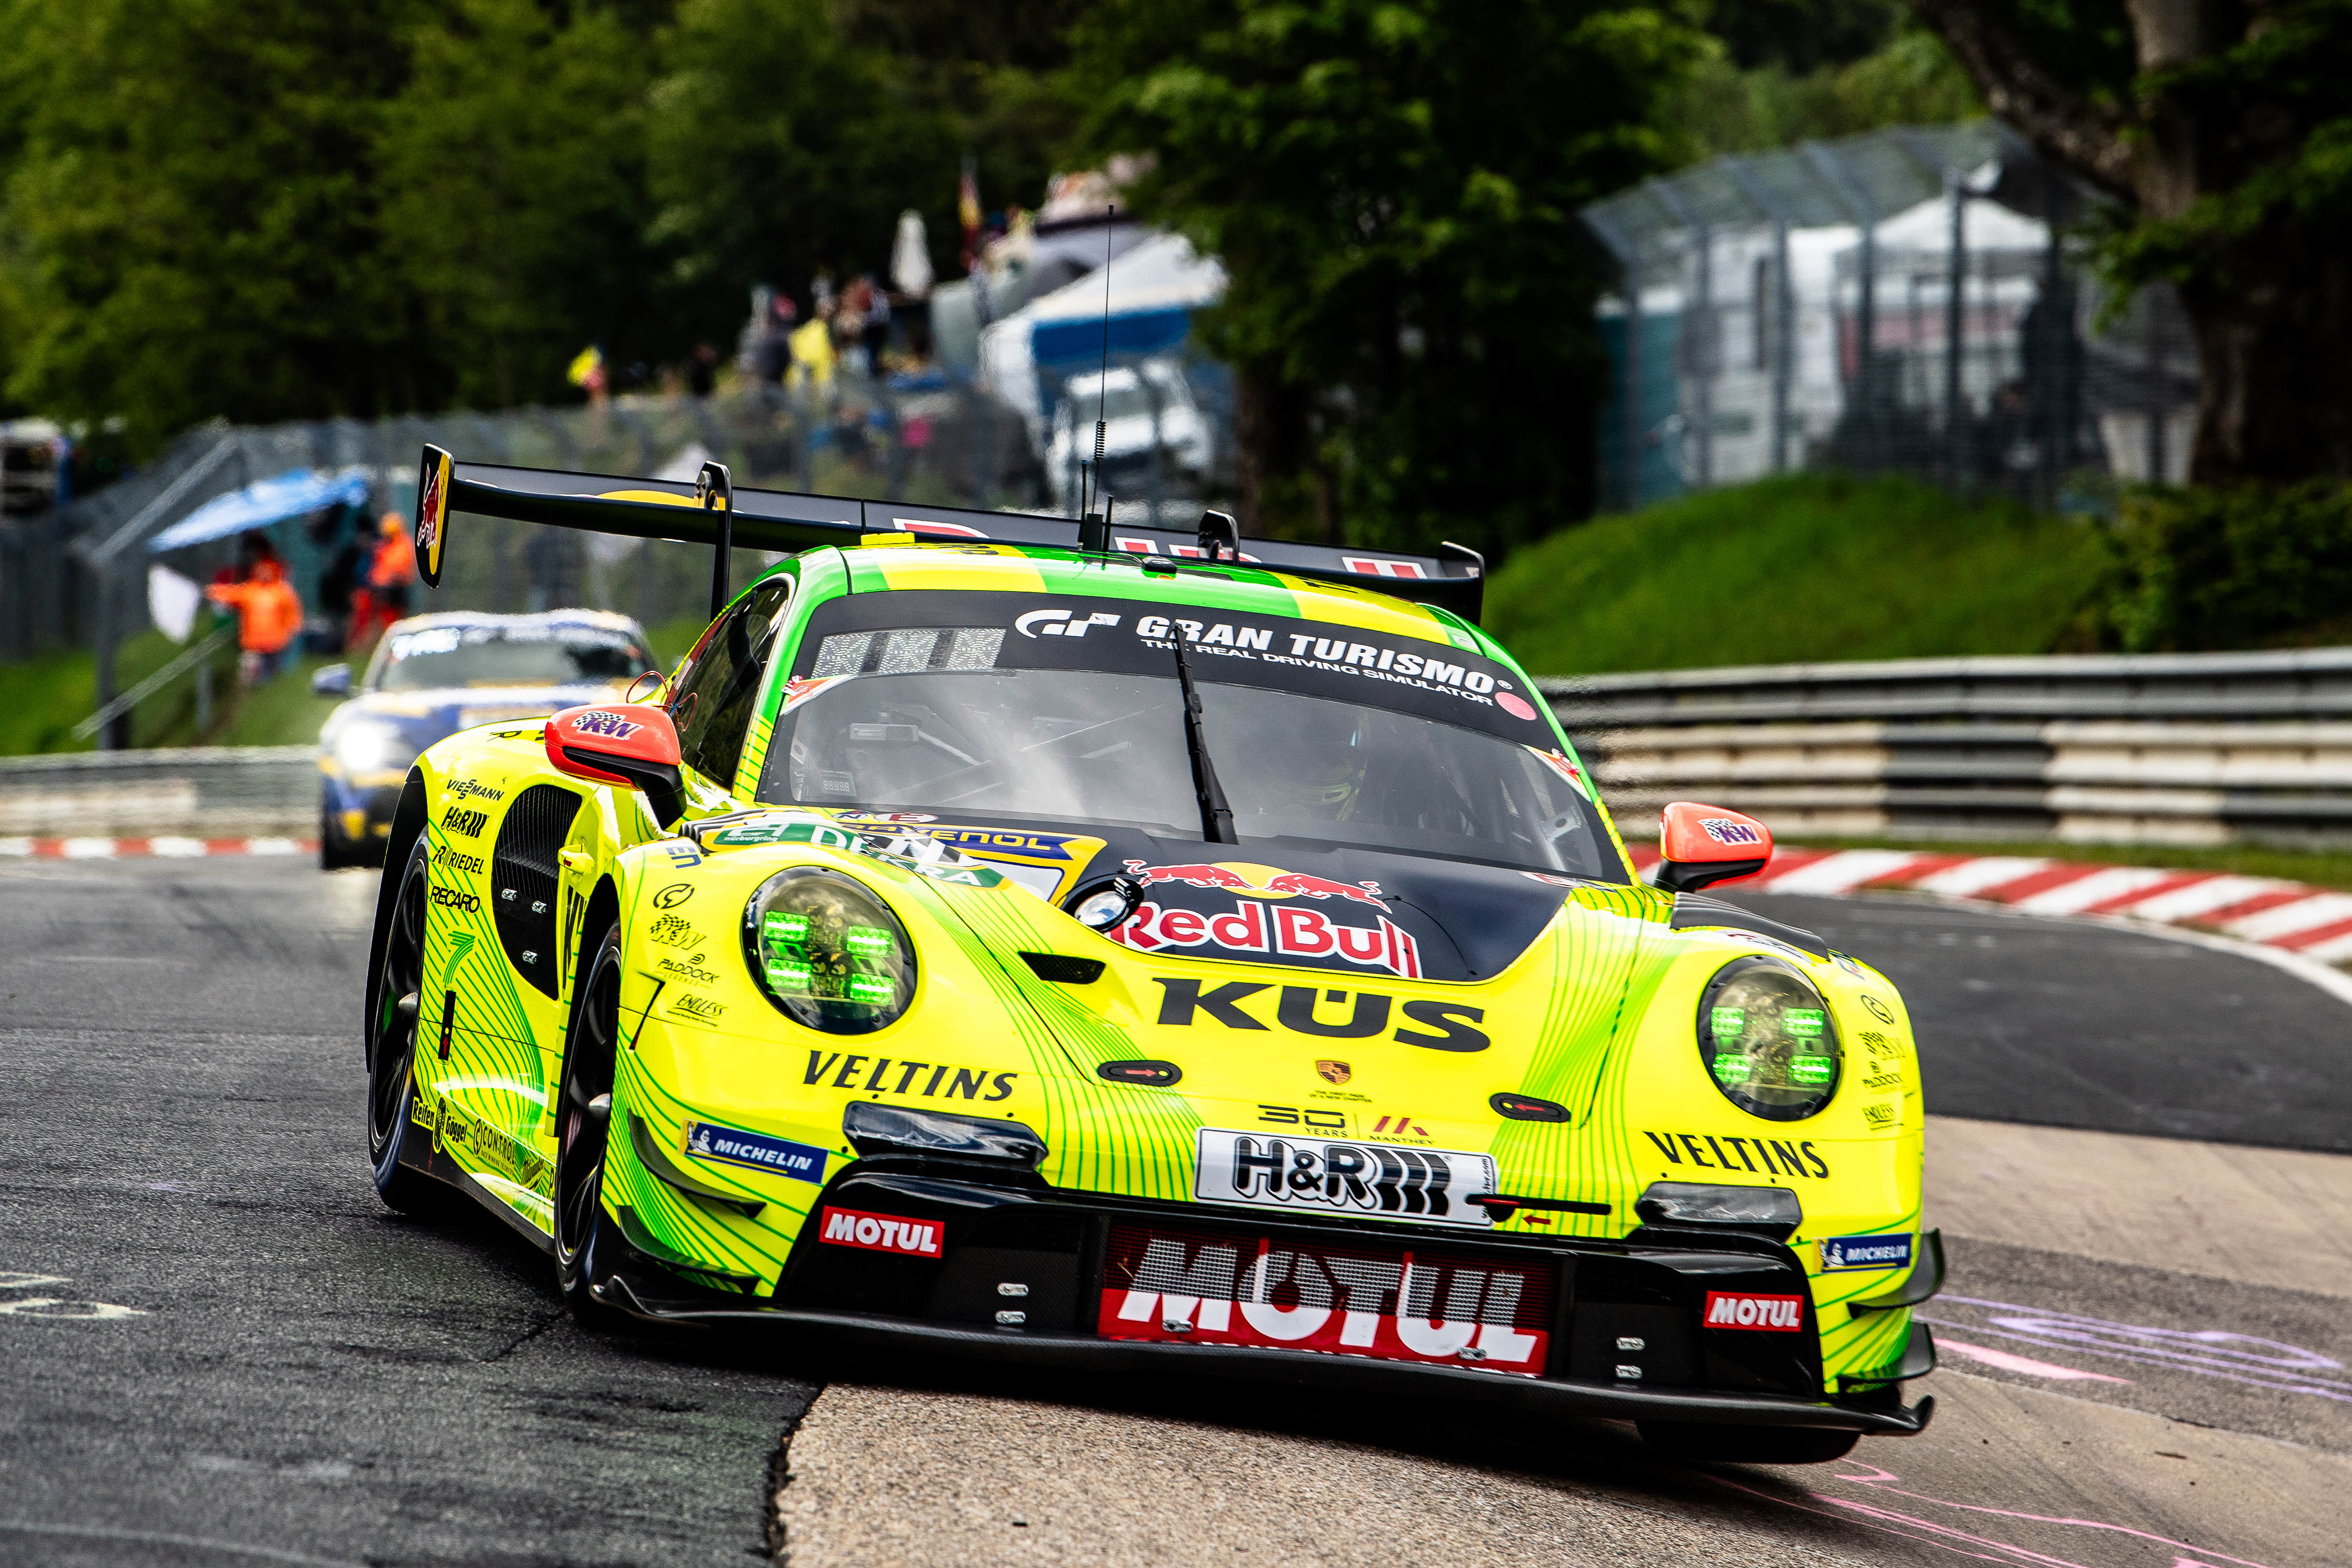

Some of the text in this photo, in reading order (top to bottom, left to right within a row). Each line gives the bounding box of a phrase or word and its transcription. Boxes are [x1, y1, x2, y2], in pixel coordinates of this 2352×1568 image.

[1136, 616, 1273, 650] GRAN
[1195, 644, 1257, 660] REAL
[1263, 654, 1359, 675] DRIVING
[1362, 668, 1494, 706] SIMULATOR
[580, 718, 639, 737] KW
[446, 779, 504, 801] VIESSMANN
[843, 824, 1051, 850] RAVENOL
[448, 851, 485, 875] RIEDEL
[810, 825, 983, 886] DEKRA
[430, 885, 480, 914] RECARO
[1109, 902, 1421, 978] Red Bull
[658, 959, 720, 983] PADDOCK
[676, 994, 729, 1016] ENDLESS
[1152, 977, 1491, 1053] KÜS
[802, 1050, 1019, 1101] VELTINS
[413, 1101, 434, 1128] Reifen
[445, 1115, 468, 1144] Göggel
[1258, 1104, 1346, 1128] 30
[1305, 1127, 1348, 1138] YEARS
[1368, 1135, 1435, 1146] MANTHEY
[714, 1139, 814, 1171] MICHELIN
[1642, 1131, 1829, 1179] VELTINS
[824, 1212, 938, 1253] MOTUL
[1846, 1246, 1908, 1261] MICHELIN
[1117, 1238, 1538, 1363] MOTUL
[1709, 1297, 1801, 1328] MOTUL
